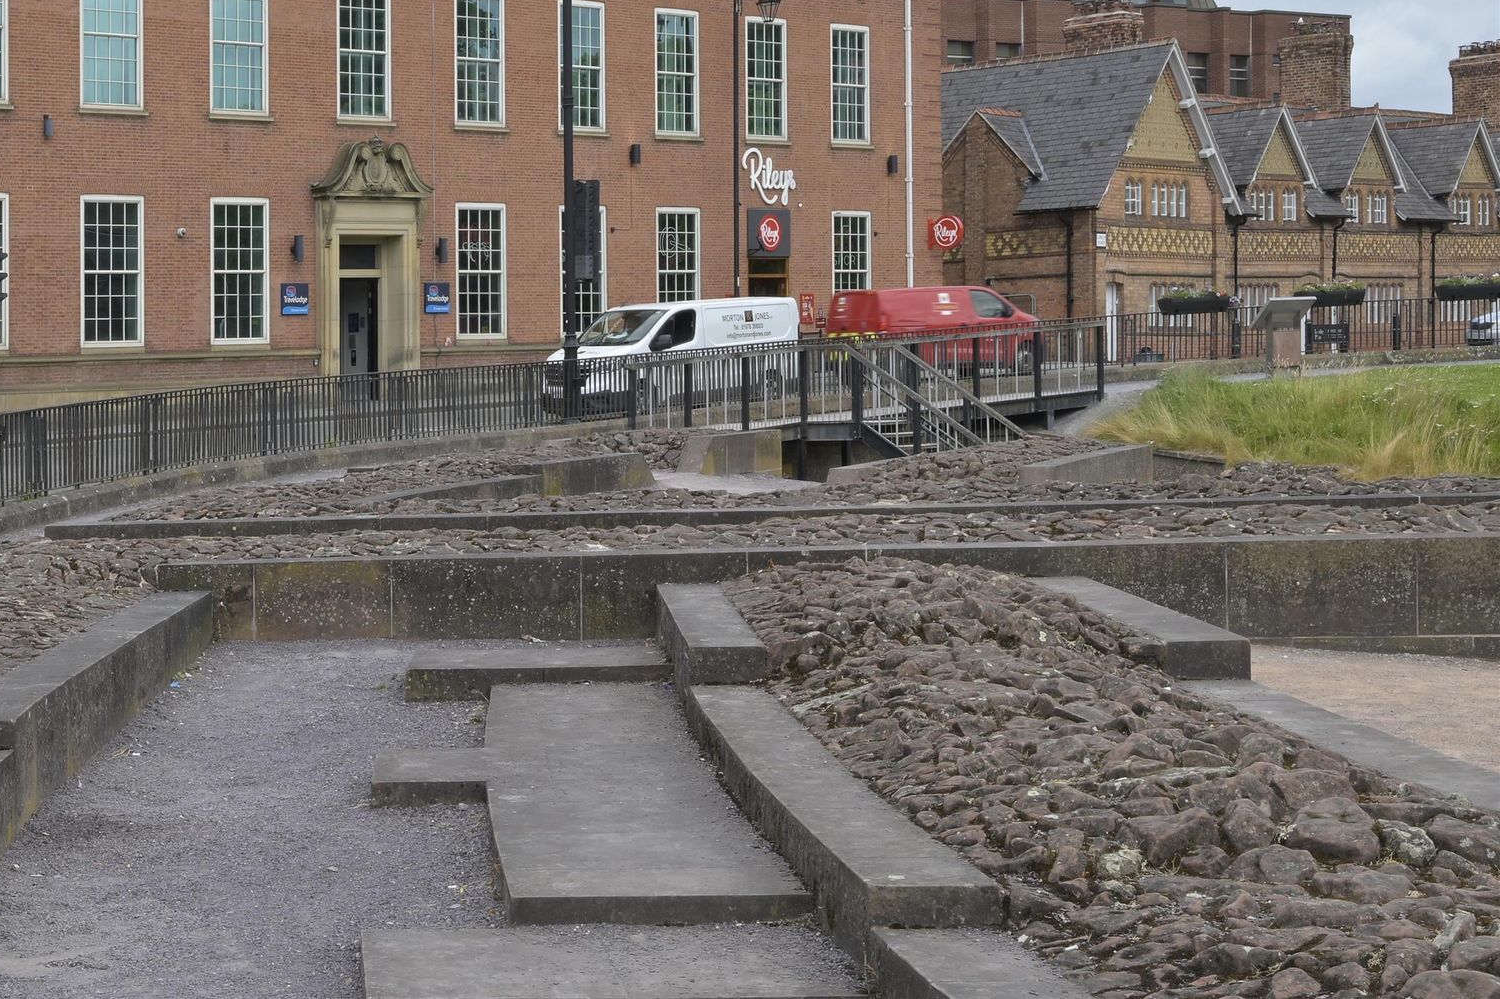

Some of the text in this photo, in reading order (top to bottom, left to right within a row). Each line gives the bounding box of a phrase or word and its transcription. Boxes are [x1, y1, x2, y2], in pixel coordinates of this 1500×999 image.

[742, 147, 796, 206] Rileys
[933, 223, 957, 241] Rileys
[283, 295, 308, 304] Travelodge
[426, 294, 449, 303] Travelodge
[722, 314, 744, 322] MORTON
[755, 312, 770, 321] JONES
